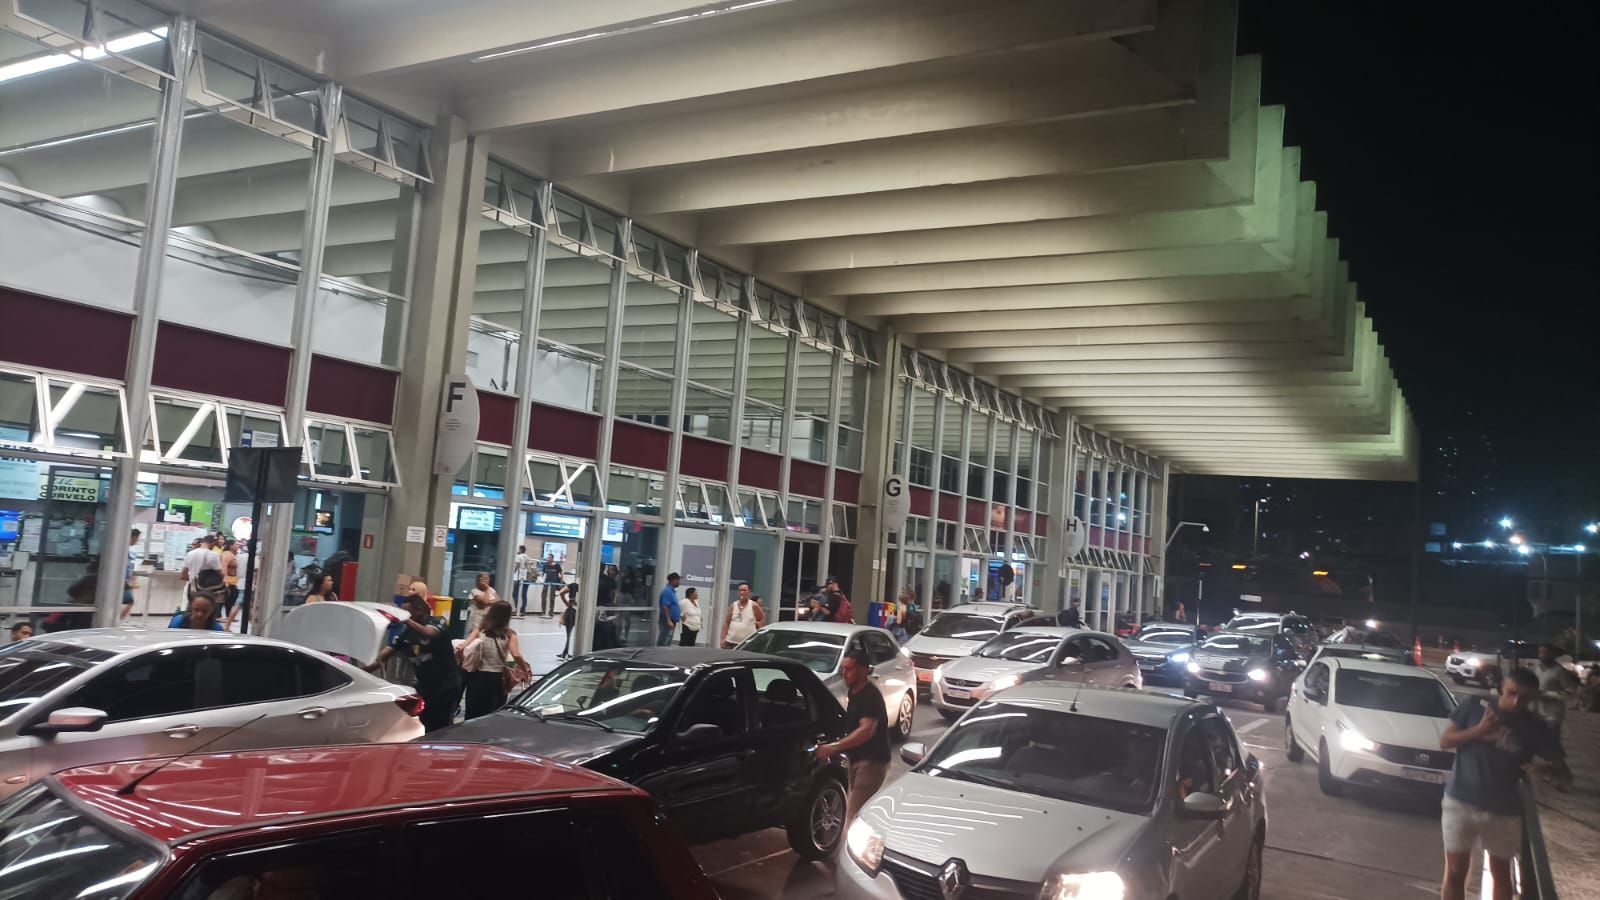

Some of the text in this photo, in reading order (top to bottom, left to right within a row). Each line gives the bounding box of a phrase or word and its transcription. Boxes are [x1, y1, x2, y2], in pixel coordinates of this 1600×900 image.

[446, 382, 466, 413] F
[886, 478, 901, 497] G
[1066, 518, 1077, 532] H
